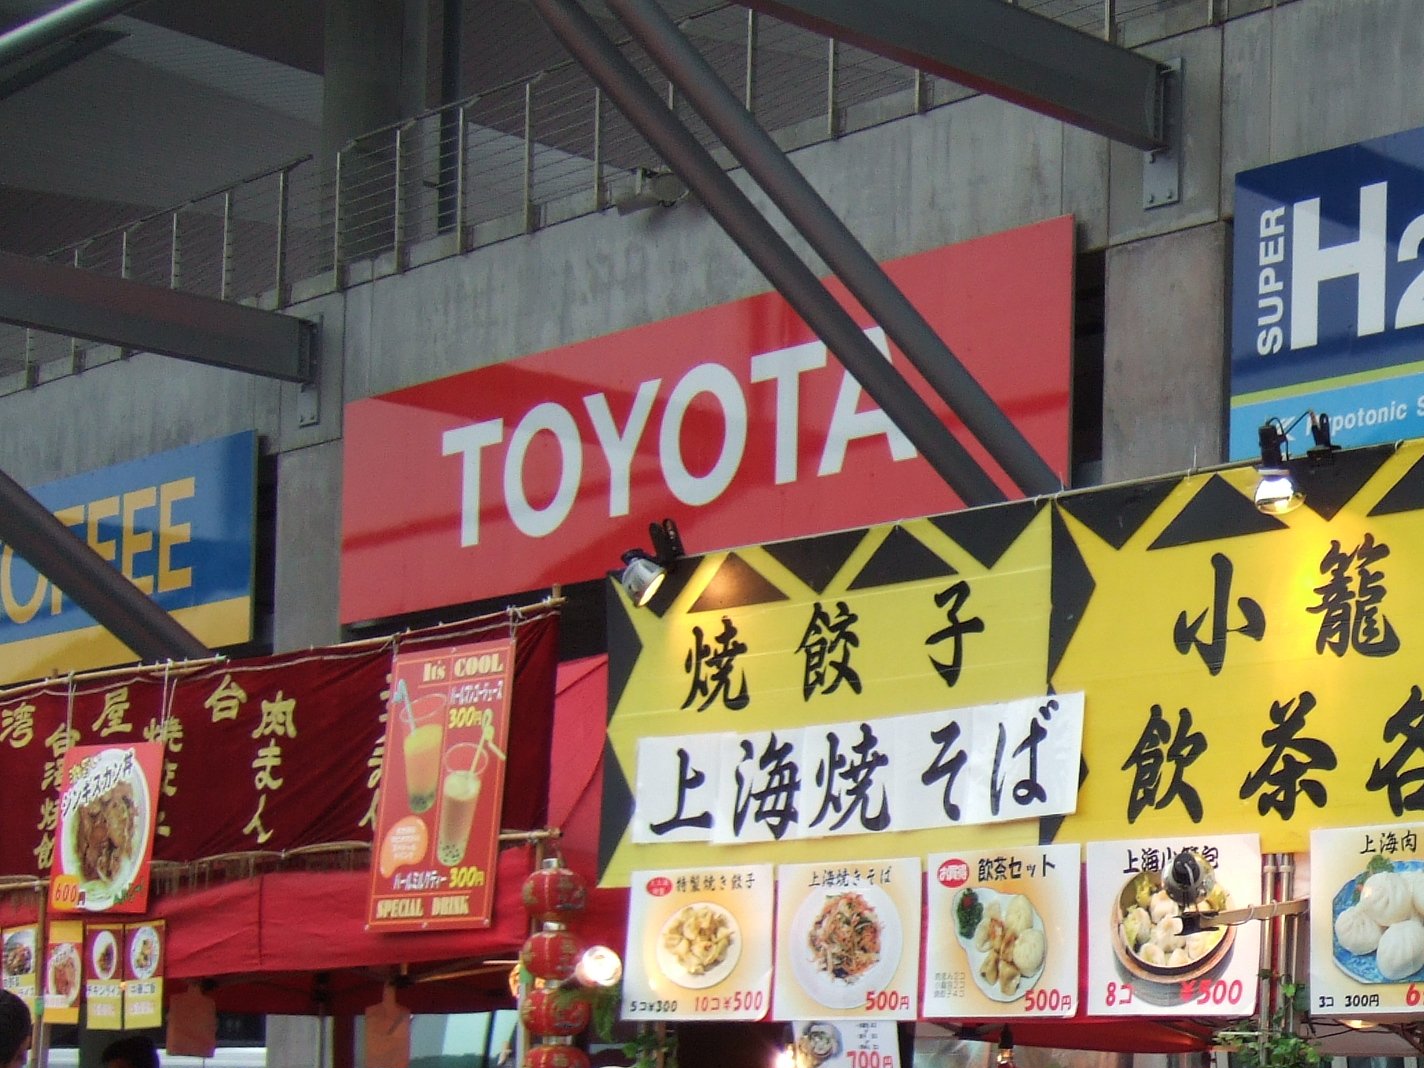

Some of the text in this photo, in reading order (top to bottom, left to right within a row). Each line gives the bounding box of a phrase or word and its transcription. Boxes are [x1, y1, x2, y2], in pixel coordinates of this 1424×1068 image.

[1257, 206, 1285, 355] SUPER
[441, 326, 918, 547] TOYOTA
[681, 580, 985, 714] 焼餃子
[454, 653, 504, 677] COOL
[649, 700, 1059, 840] 上海焼そば
[977, 854, 1056, 883] 飲茶セット
[1123, 846, 1219, 875] 上海小包
[808, 865, 893, 888] 上海焼きそば
[376, 895, 470, 919] SPECIAL DRINK
[865, 991, 909, 1012] 500円
[1024, 988, 1072, 1011] 500円
[1180, 979, 1244, 1005] ¥500
[1344, 993, 1380, 1008] 300円
